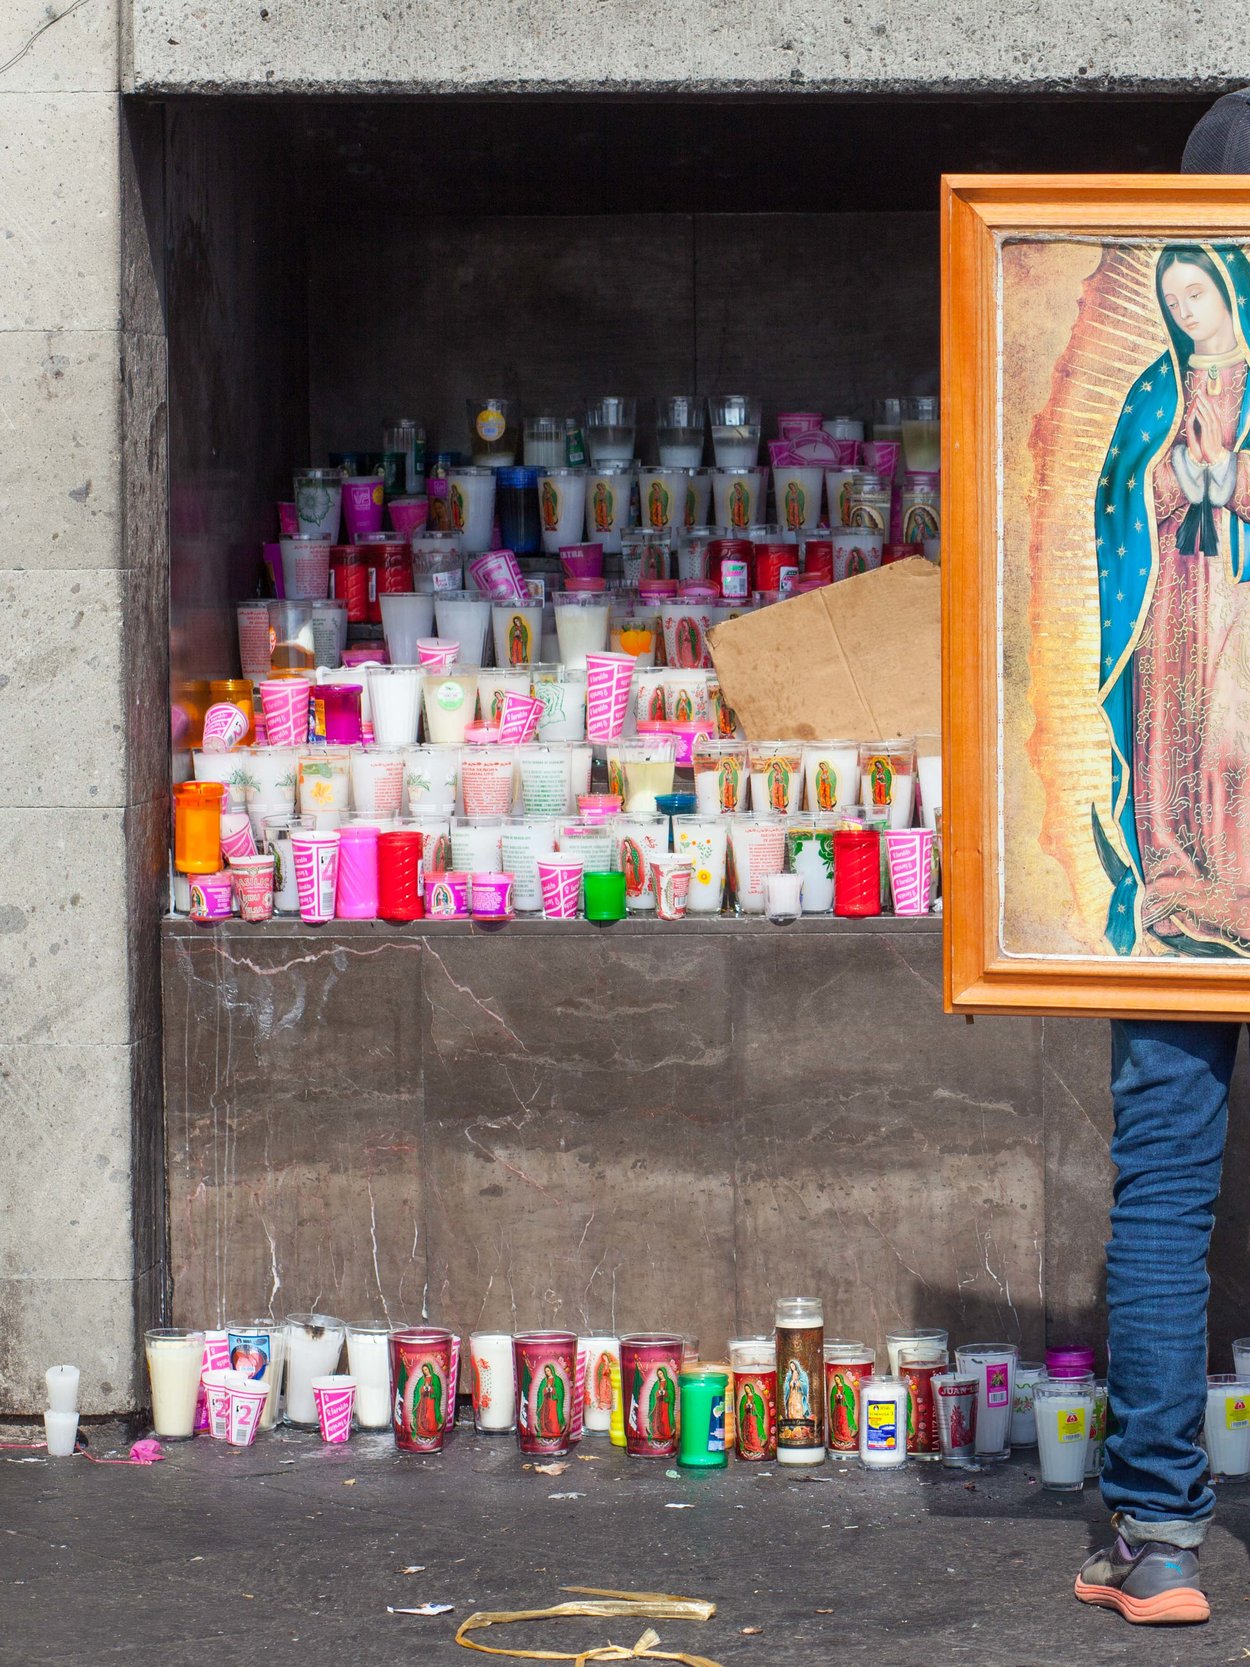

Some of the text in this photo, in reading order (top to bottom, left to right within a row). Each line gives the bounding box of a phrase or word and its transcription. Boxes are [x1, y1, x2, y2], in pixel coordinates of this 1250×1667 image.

[321, 852, 338, 890] 4
[237, 1404, 252, 1426] 2
[330, 1402, 349, 1416] farolito
